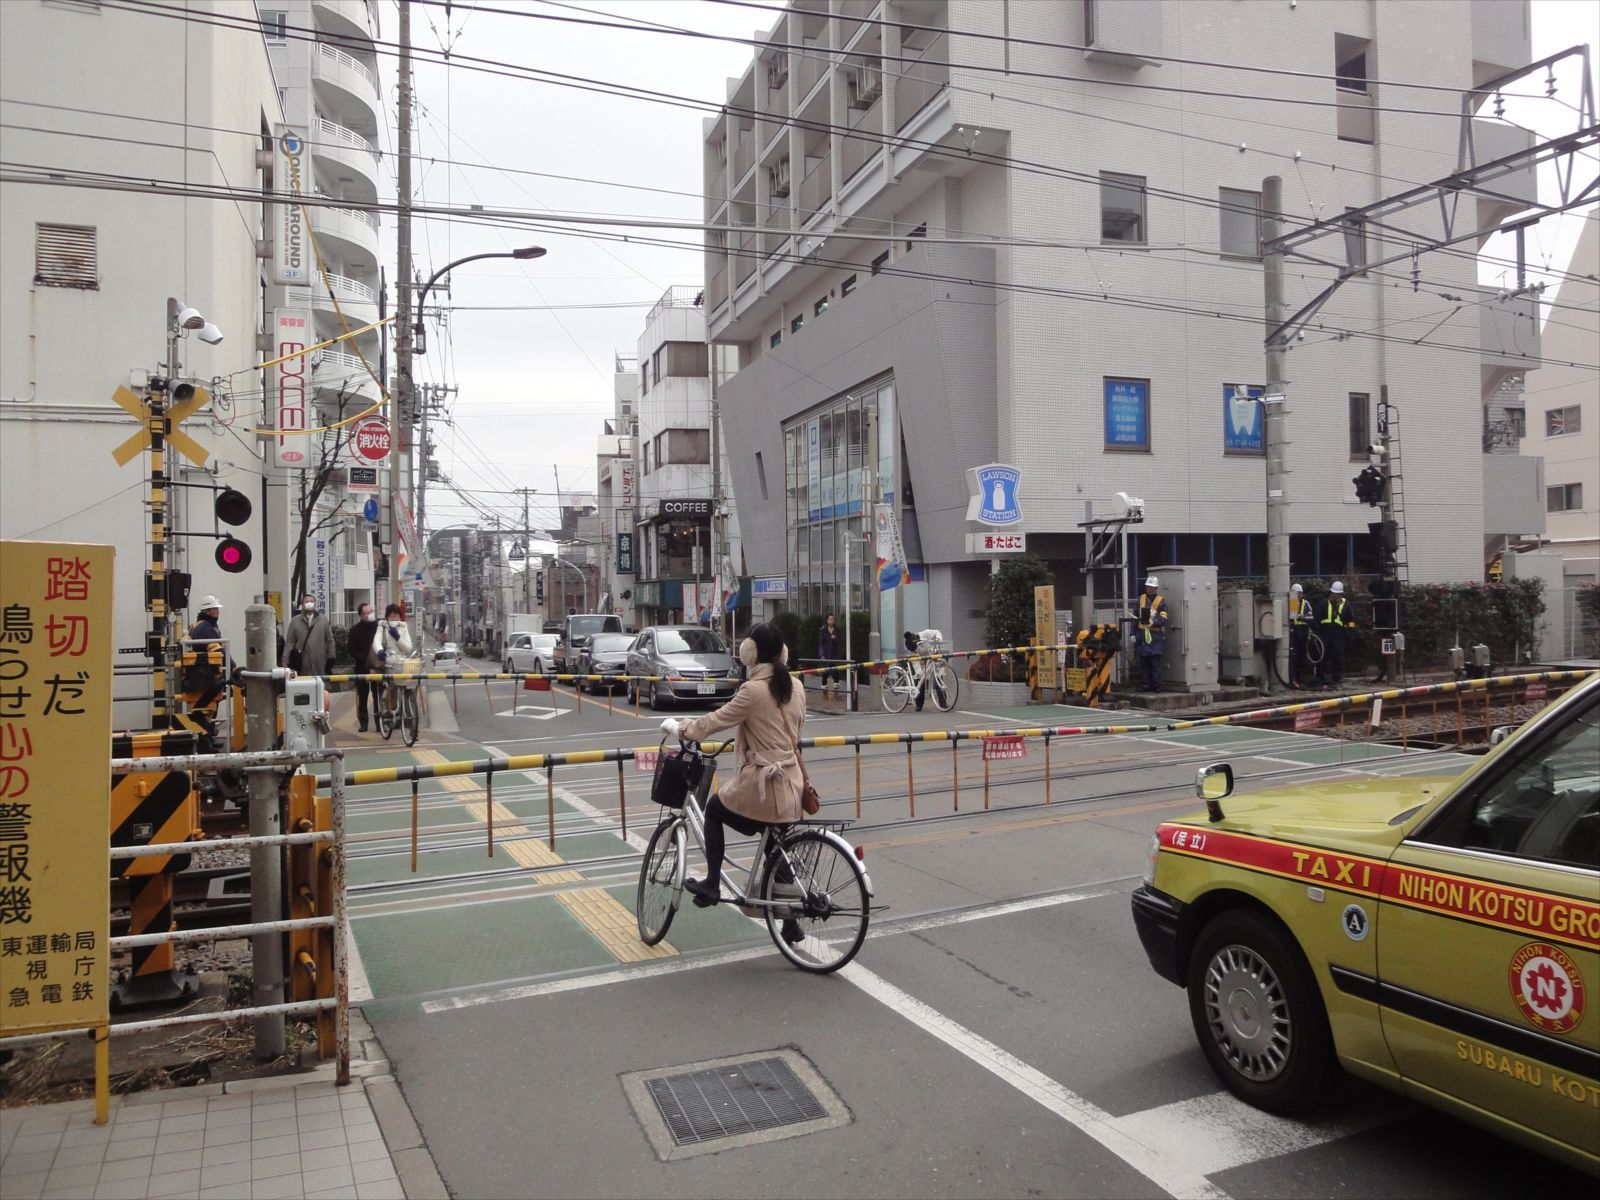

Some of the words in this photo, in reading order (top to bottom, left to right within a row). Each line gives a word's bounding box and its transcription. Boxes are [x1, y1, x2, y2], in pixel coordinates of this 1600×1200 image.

[290, 204, 301, 269] AROUND
[280, 342, 305, 447] EXCEL
[360, 433, 390, 449] 消火栓
[982, 471, 1016, 482] LAWSON
[664, 502, 708, 513] COFFEE
[982, 509, 1016, 519] STATION
[44, 557, 92, 716] 踏切だ
[1292, 851, 1371, 888] TAXI
[1399, 872, 1464, 909] NIHON
[1468, 887, 1544, 927] KOTSU
[1349, 913, 1361, 931] A
[1, 930, 95, 957] 東運輸局
[1513, 945, 1543, 973] NIHON
[1550, 948, 1581, 988] KOTSU
[1537, 976, 1556, 1000] N
[1456, 1040, 1542, 1087] SUBARU
